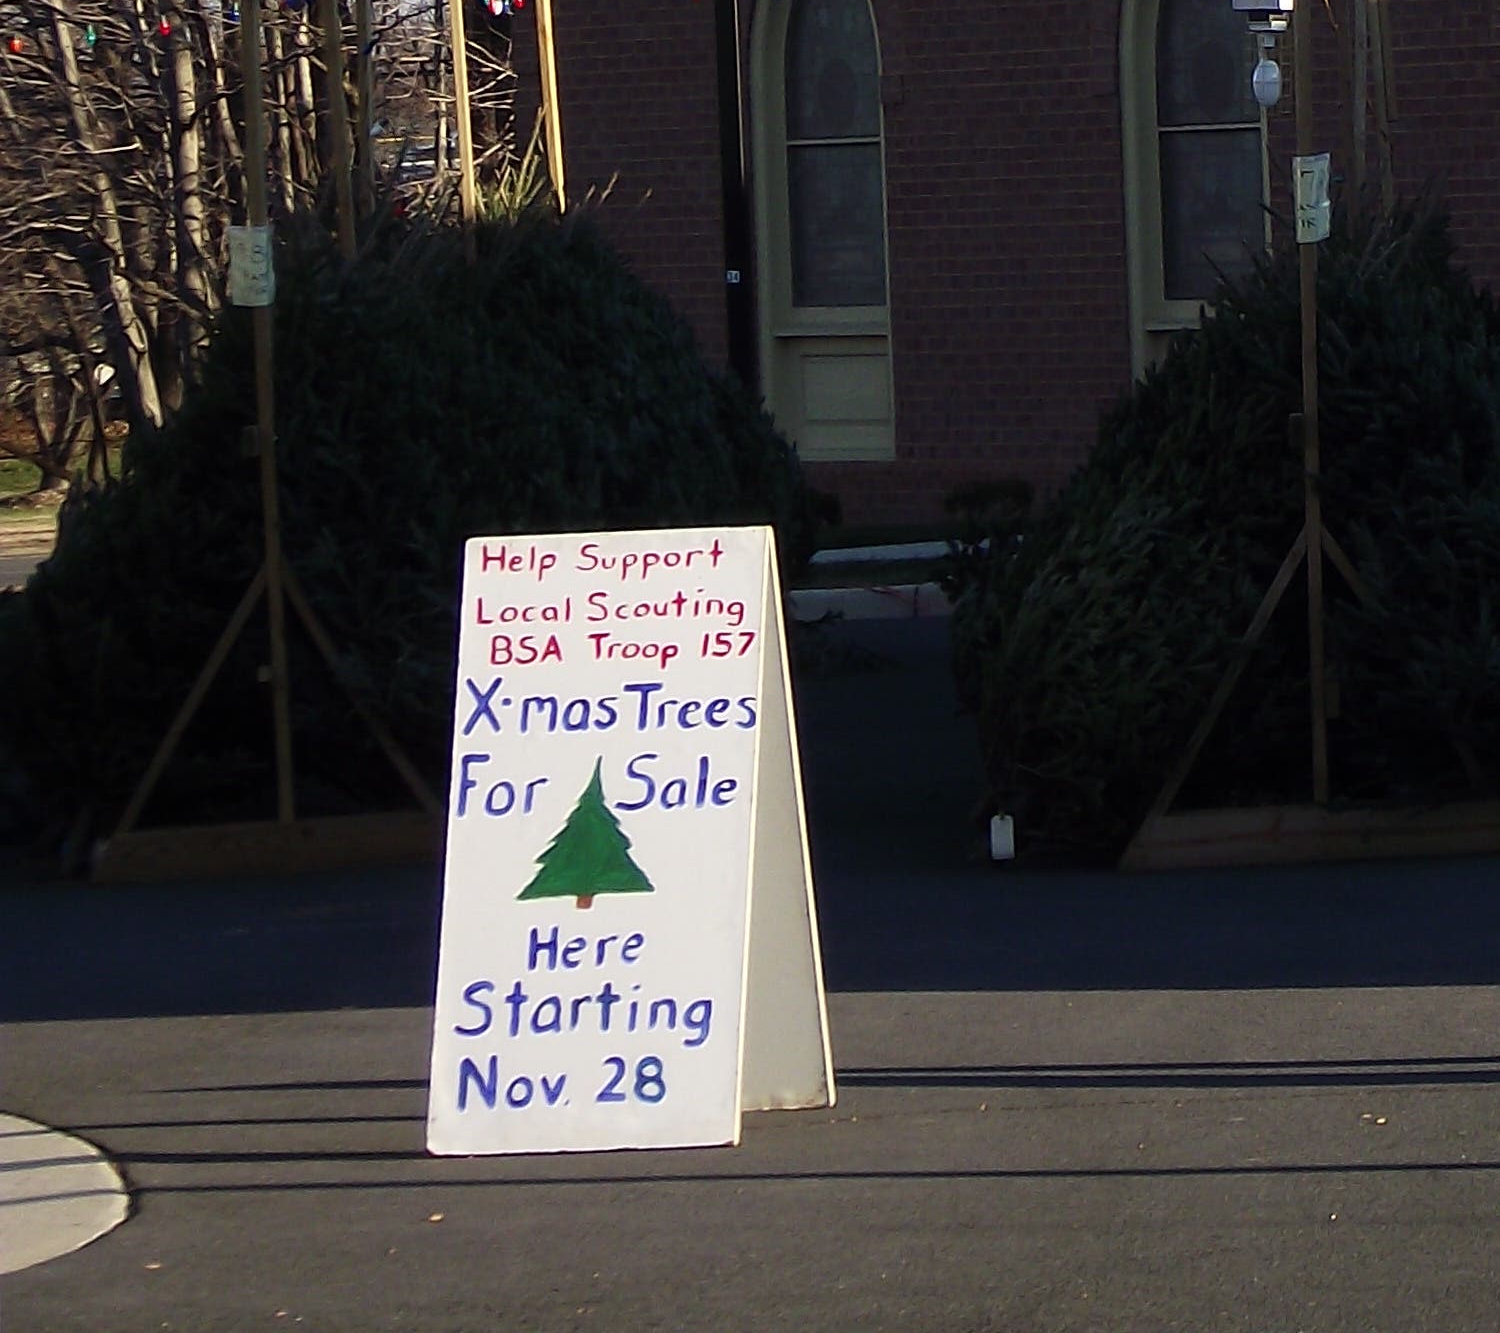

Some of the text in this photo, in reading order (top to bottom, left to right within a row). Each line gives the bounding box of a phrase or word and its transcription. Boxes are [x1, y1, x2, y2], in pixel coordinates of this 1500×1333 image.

[481, 539, 724, 582] Help Support
[476, 589, 746, 627] Local Scouting
[490, 631, 756, 670] BSA Troop 157
[622, 682, 757, 731] Trees
[456, 753, 738, 818] For Sale
[527, 926, 645, 971] Here
[453, 979, 714, 1048] Starting
[595, 1054, 667, 1105] 28
